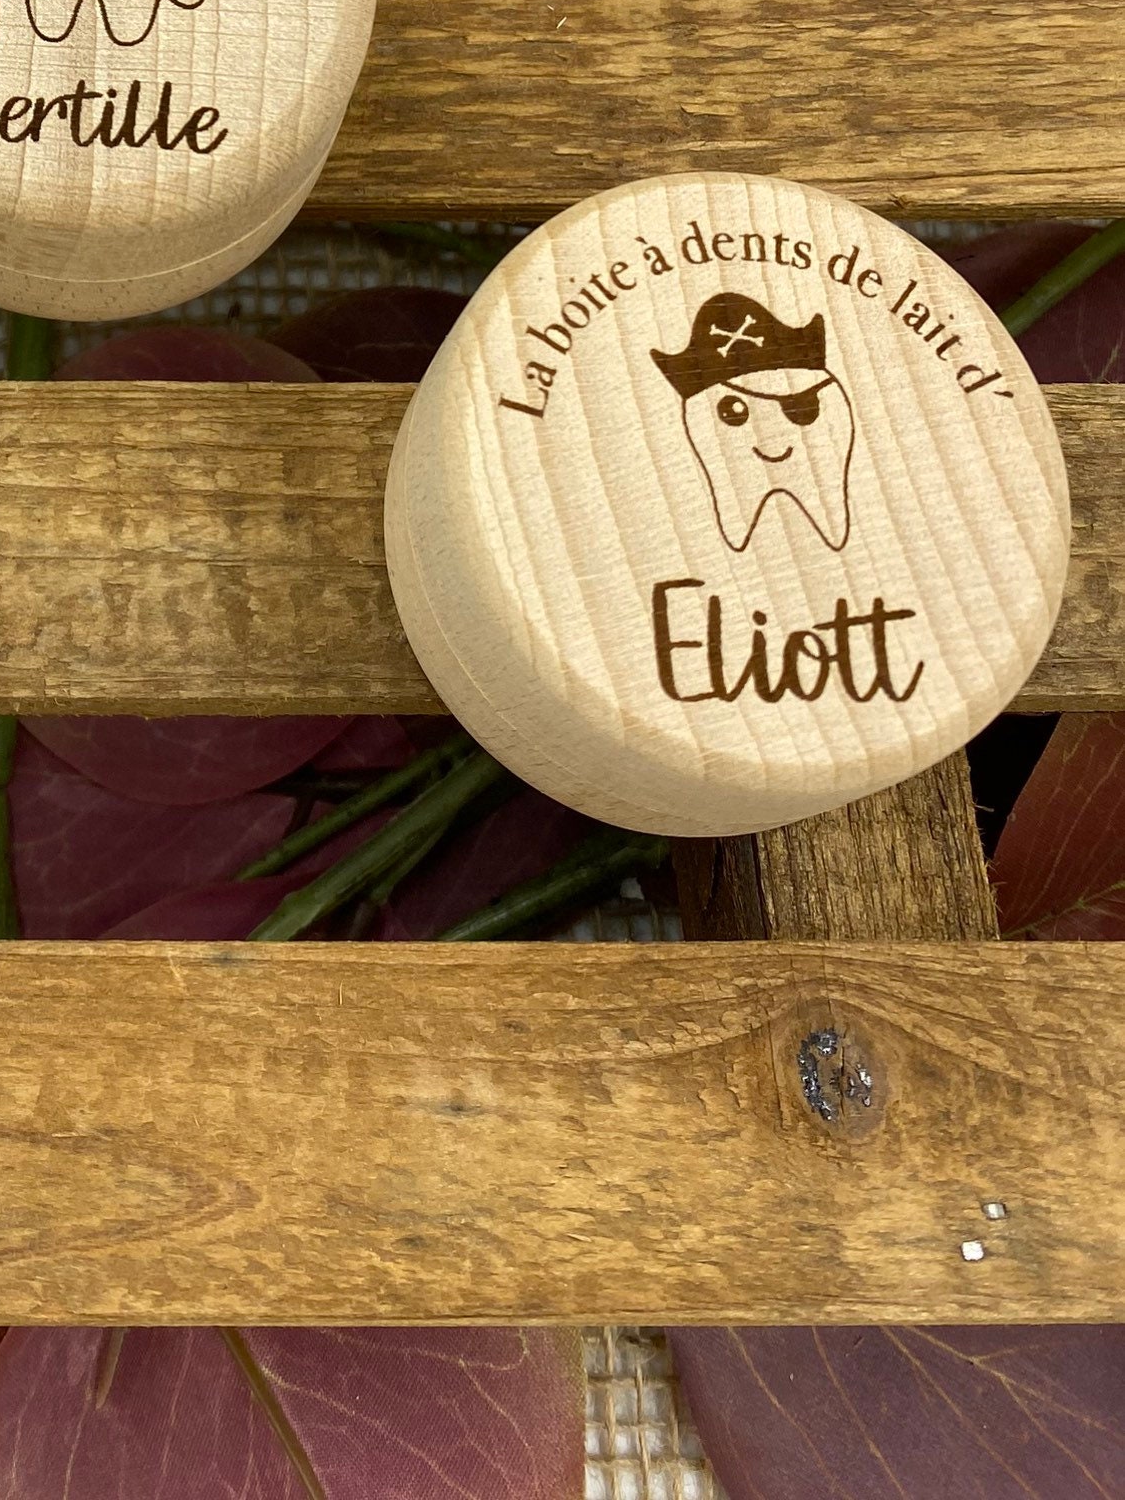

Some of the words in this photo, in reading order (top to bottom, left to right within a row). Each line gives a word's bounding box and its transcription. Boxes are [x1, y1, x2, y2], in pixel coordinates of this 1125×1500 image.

[635, 236, 674, 276] à
[679, 221, 813, 270] dents
[827, 245, 885, 297] de
[526, 260, 637, 355] boite
[889, 279, 964, 363] lait
[498, 361, 558, 419] La
[652, 577, 924, 703] Eliott
